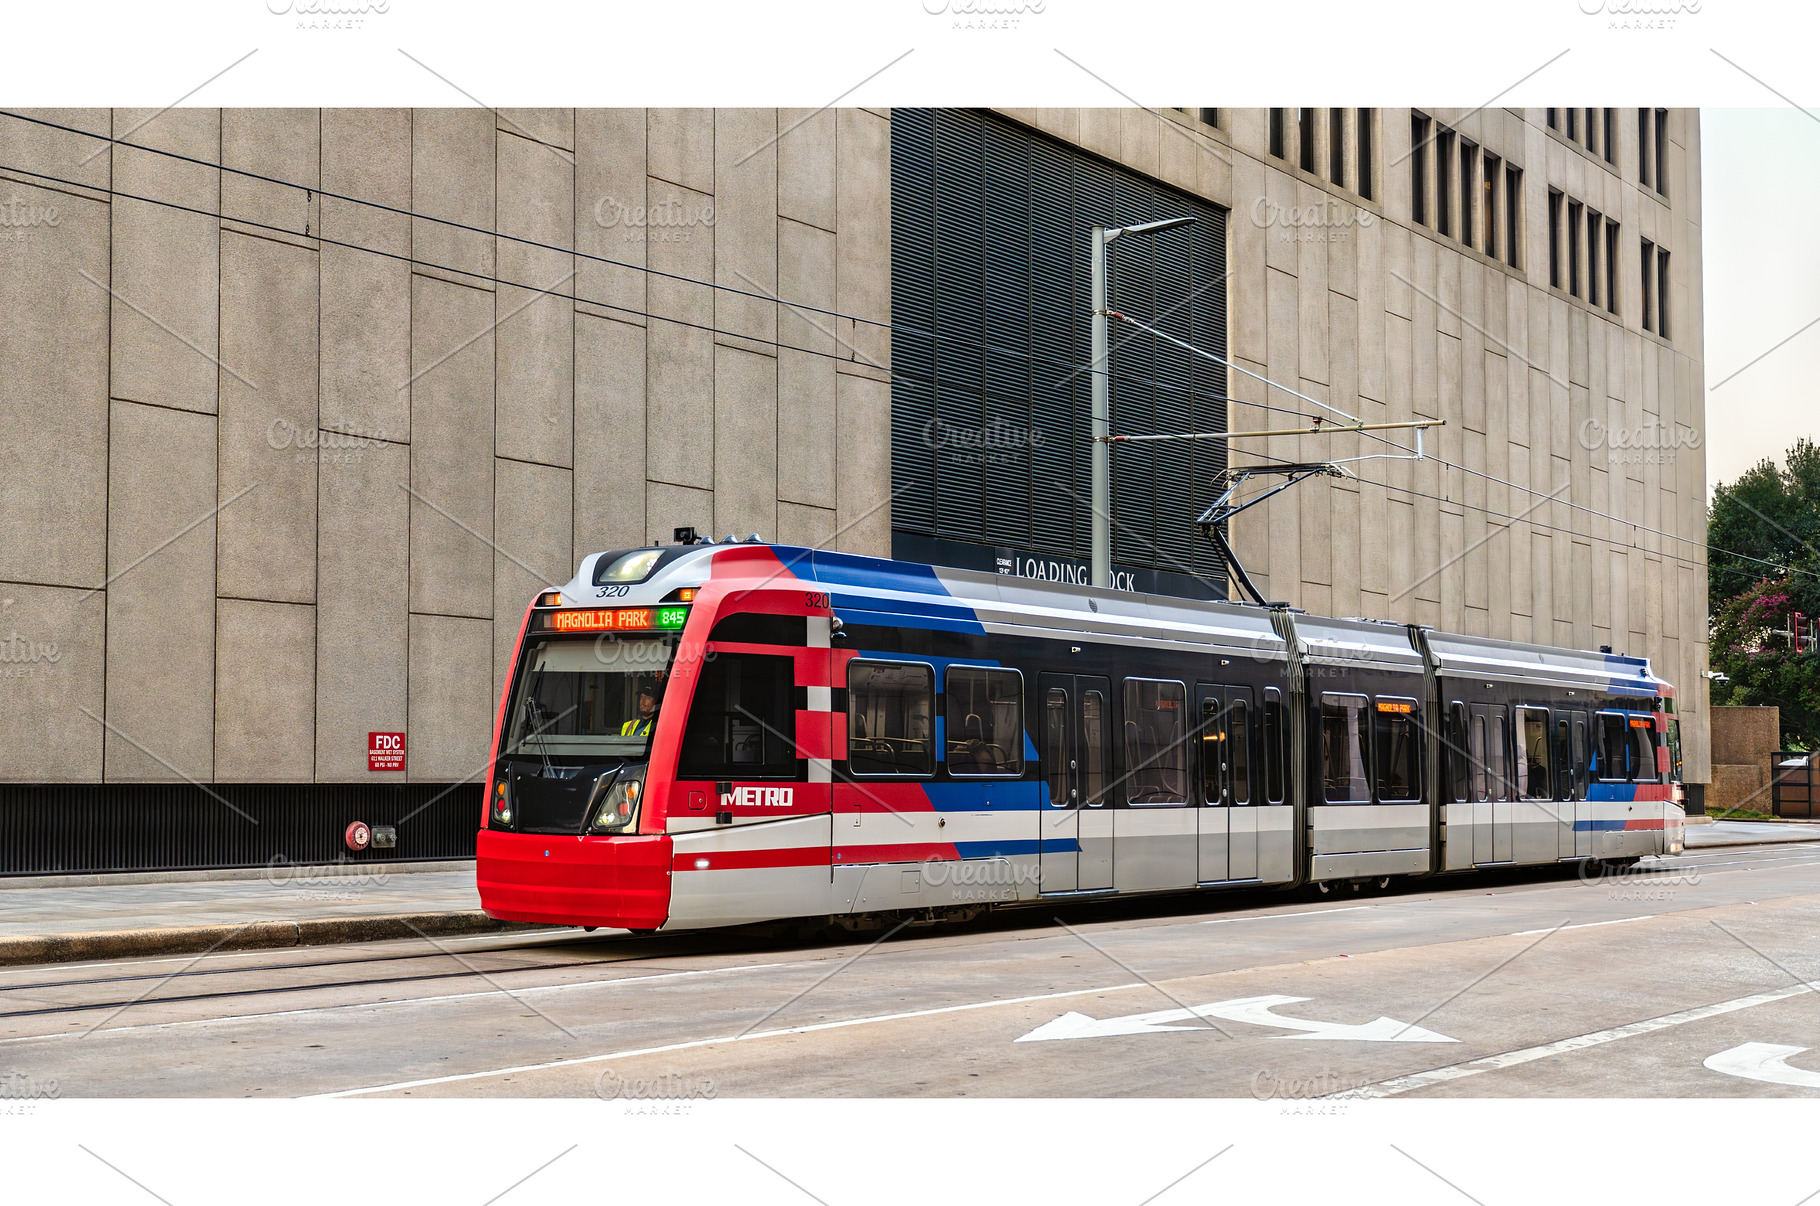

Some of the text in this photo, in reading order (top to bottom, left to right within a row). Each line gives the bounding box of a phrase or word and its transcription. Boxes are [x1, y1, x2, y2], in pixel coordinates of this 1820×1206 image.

[1016, 557, 1135, 592] LOADING OCK
[596, 585, 630, 598] 320
[805, 592, 830, 609] 320
[556, 610, 648, 628] MAGNOLIA PARK
[662, 611, 684, 624] 845
[376, 736, 400, 749] FDC
[721, 786, 793, 806] METRO
